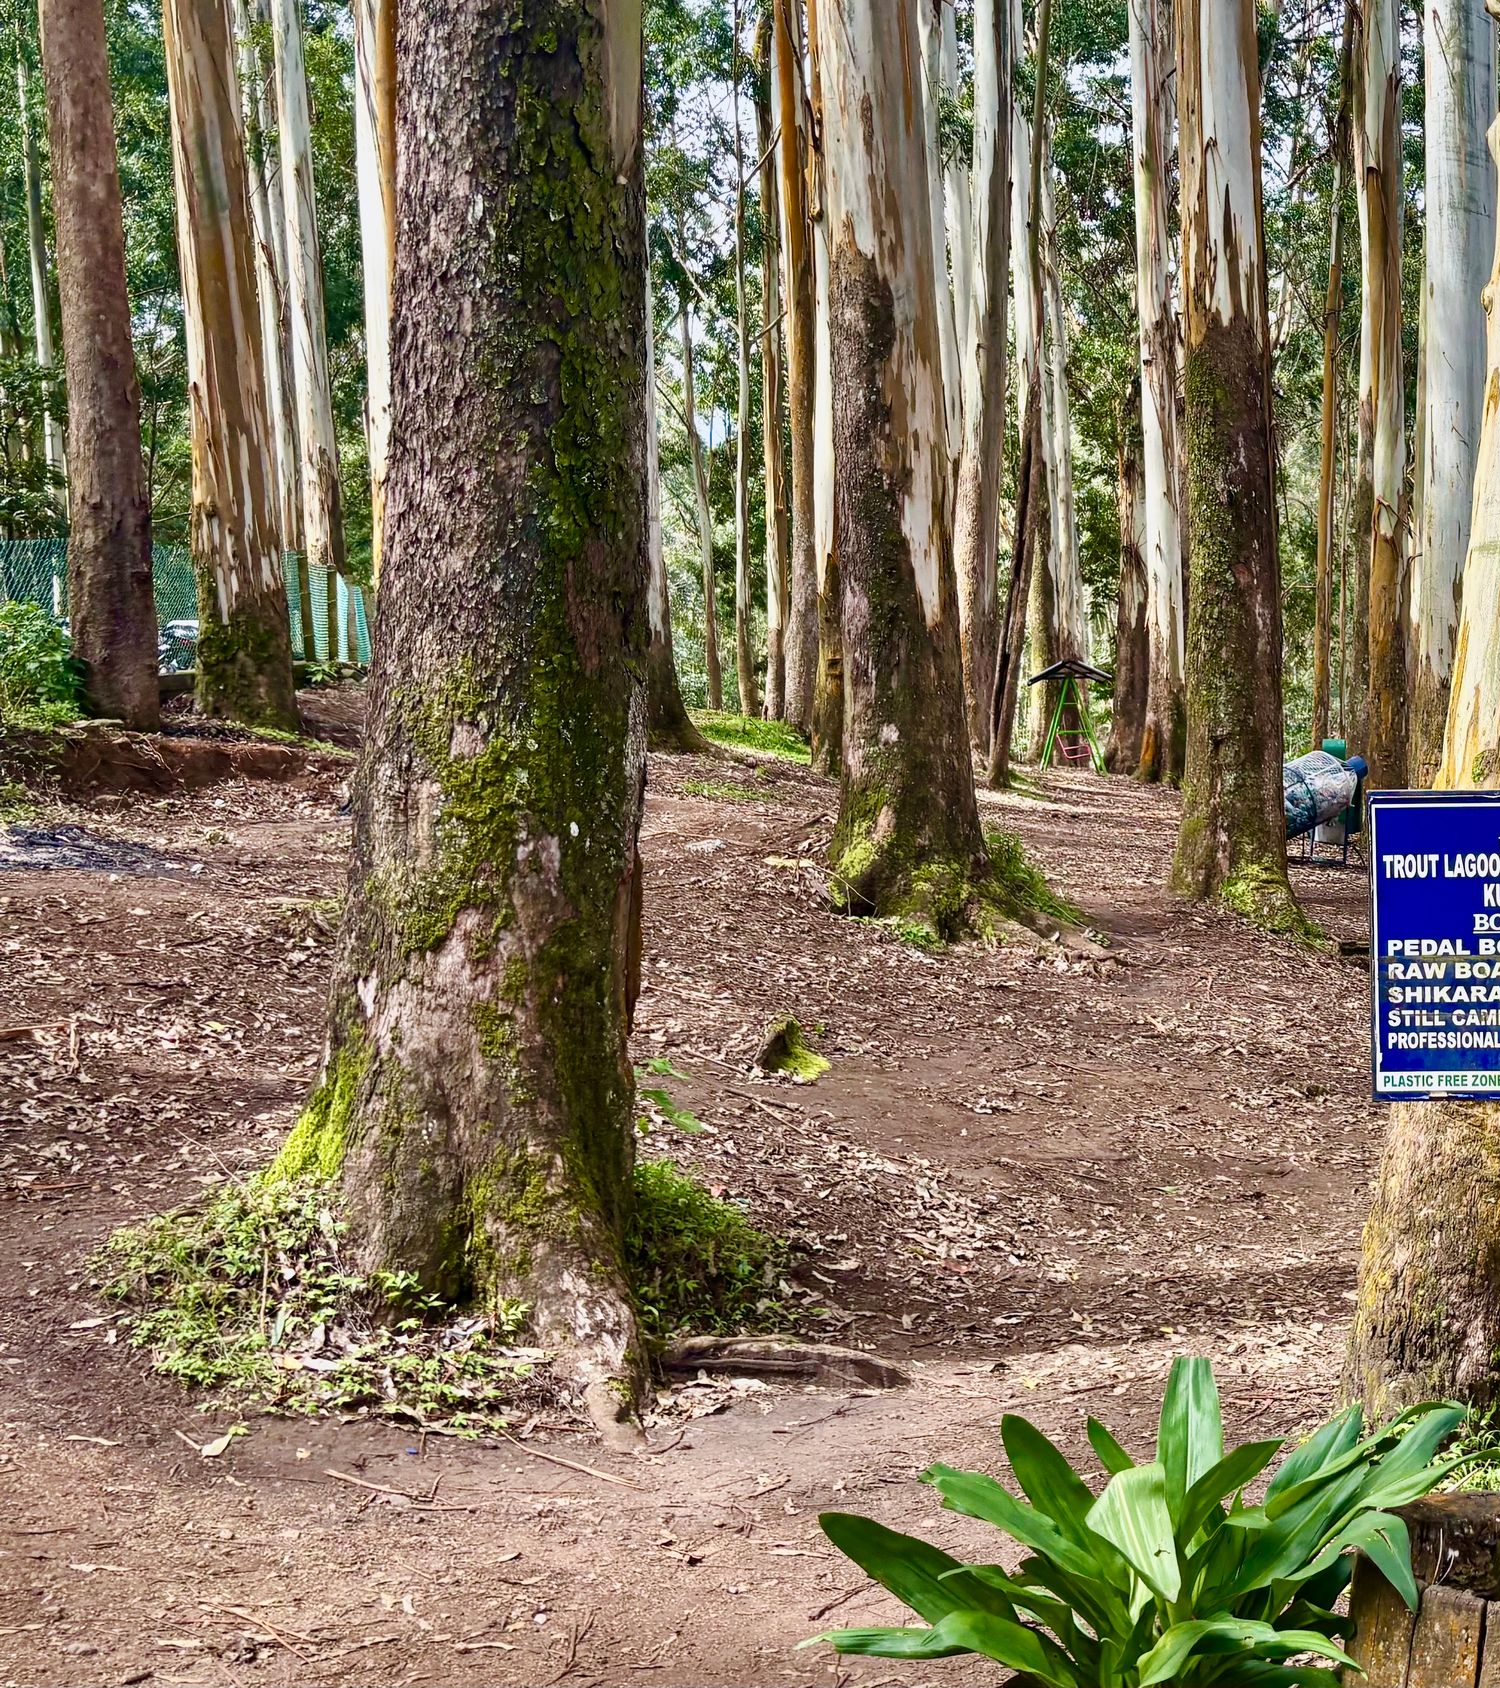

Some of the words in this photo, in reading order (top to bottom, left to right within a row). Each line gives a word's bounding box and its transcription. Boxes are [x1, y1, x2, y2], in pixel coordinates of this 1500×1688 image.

[1383, 853, 1439, 879] TROUT
[1387, 938, 1470, 956] PEDAL
[1387, 962, 1447, 980] RAW
[1388, 1009, 1448, 1027] STILL
[1383, 1074, 1436, 1088] PLASTIC
[1438, 1074, 1469, 1087] FREE
